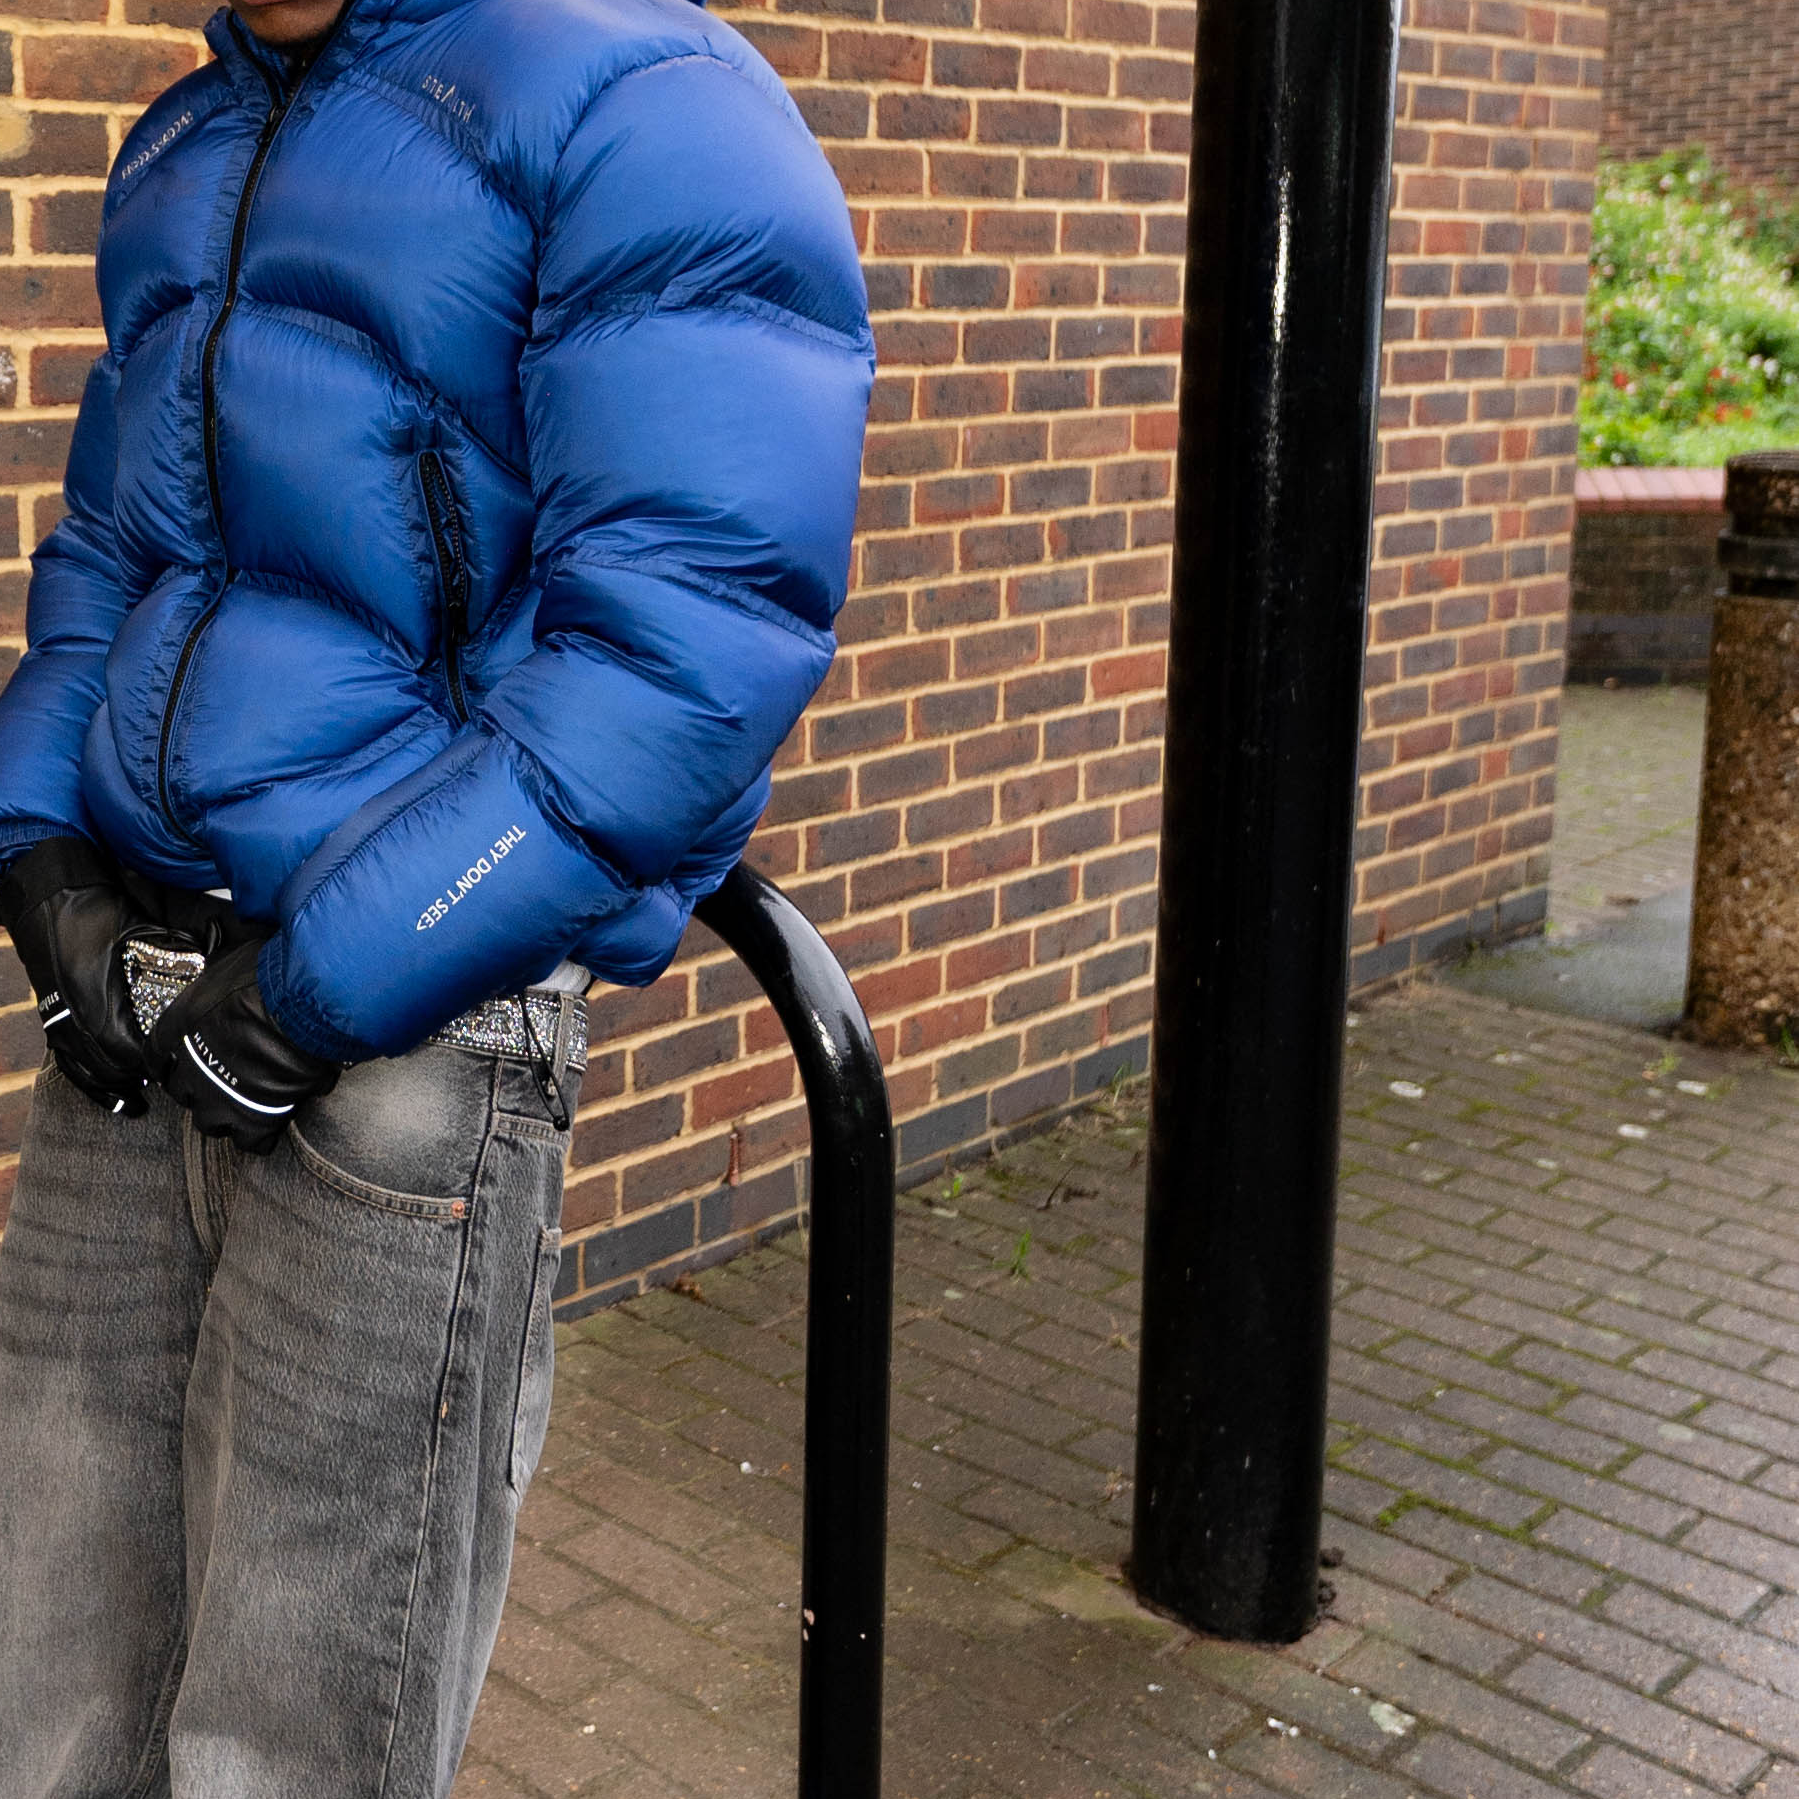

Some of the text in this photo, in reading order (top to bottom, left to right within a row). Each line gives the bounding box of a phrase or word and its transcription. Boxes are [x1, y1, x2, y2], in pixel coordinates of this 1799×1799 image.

[421, 74, 476, 123] STEALTH
[489, 824, 527, 864] THEY
[446, 857, 492, 905] DON'T
[193, 1031, 238, 1086] STEALTH
